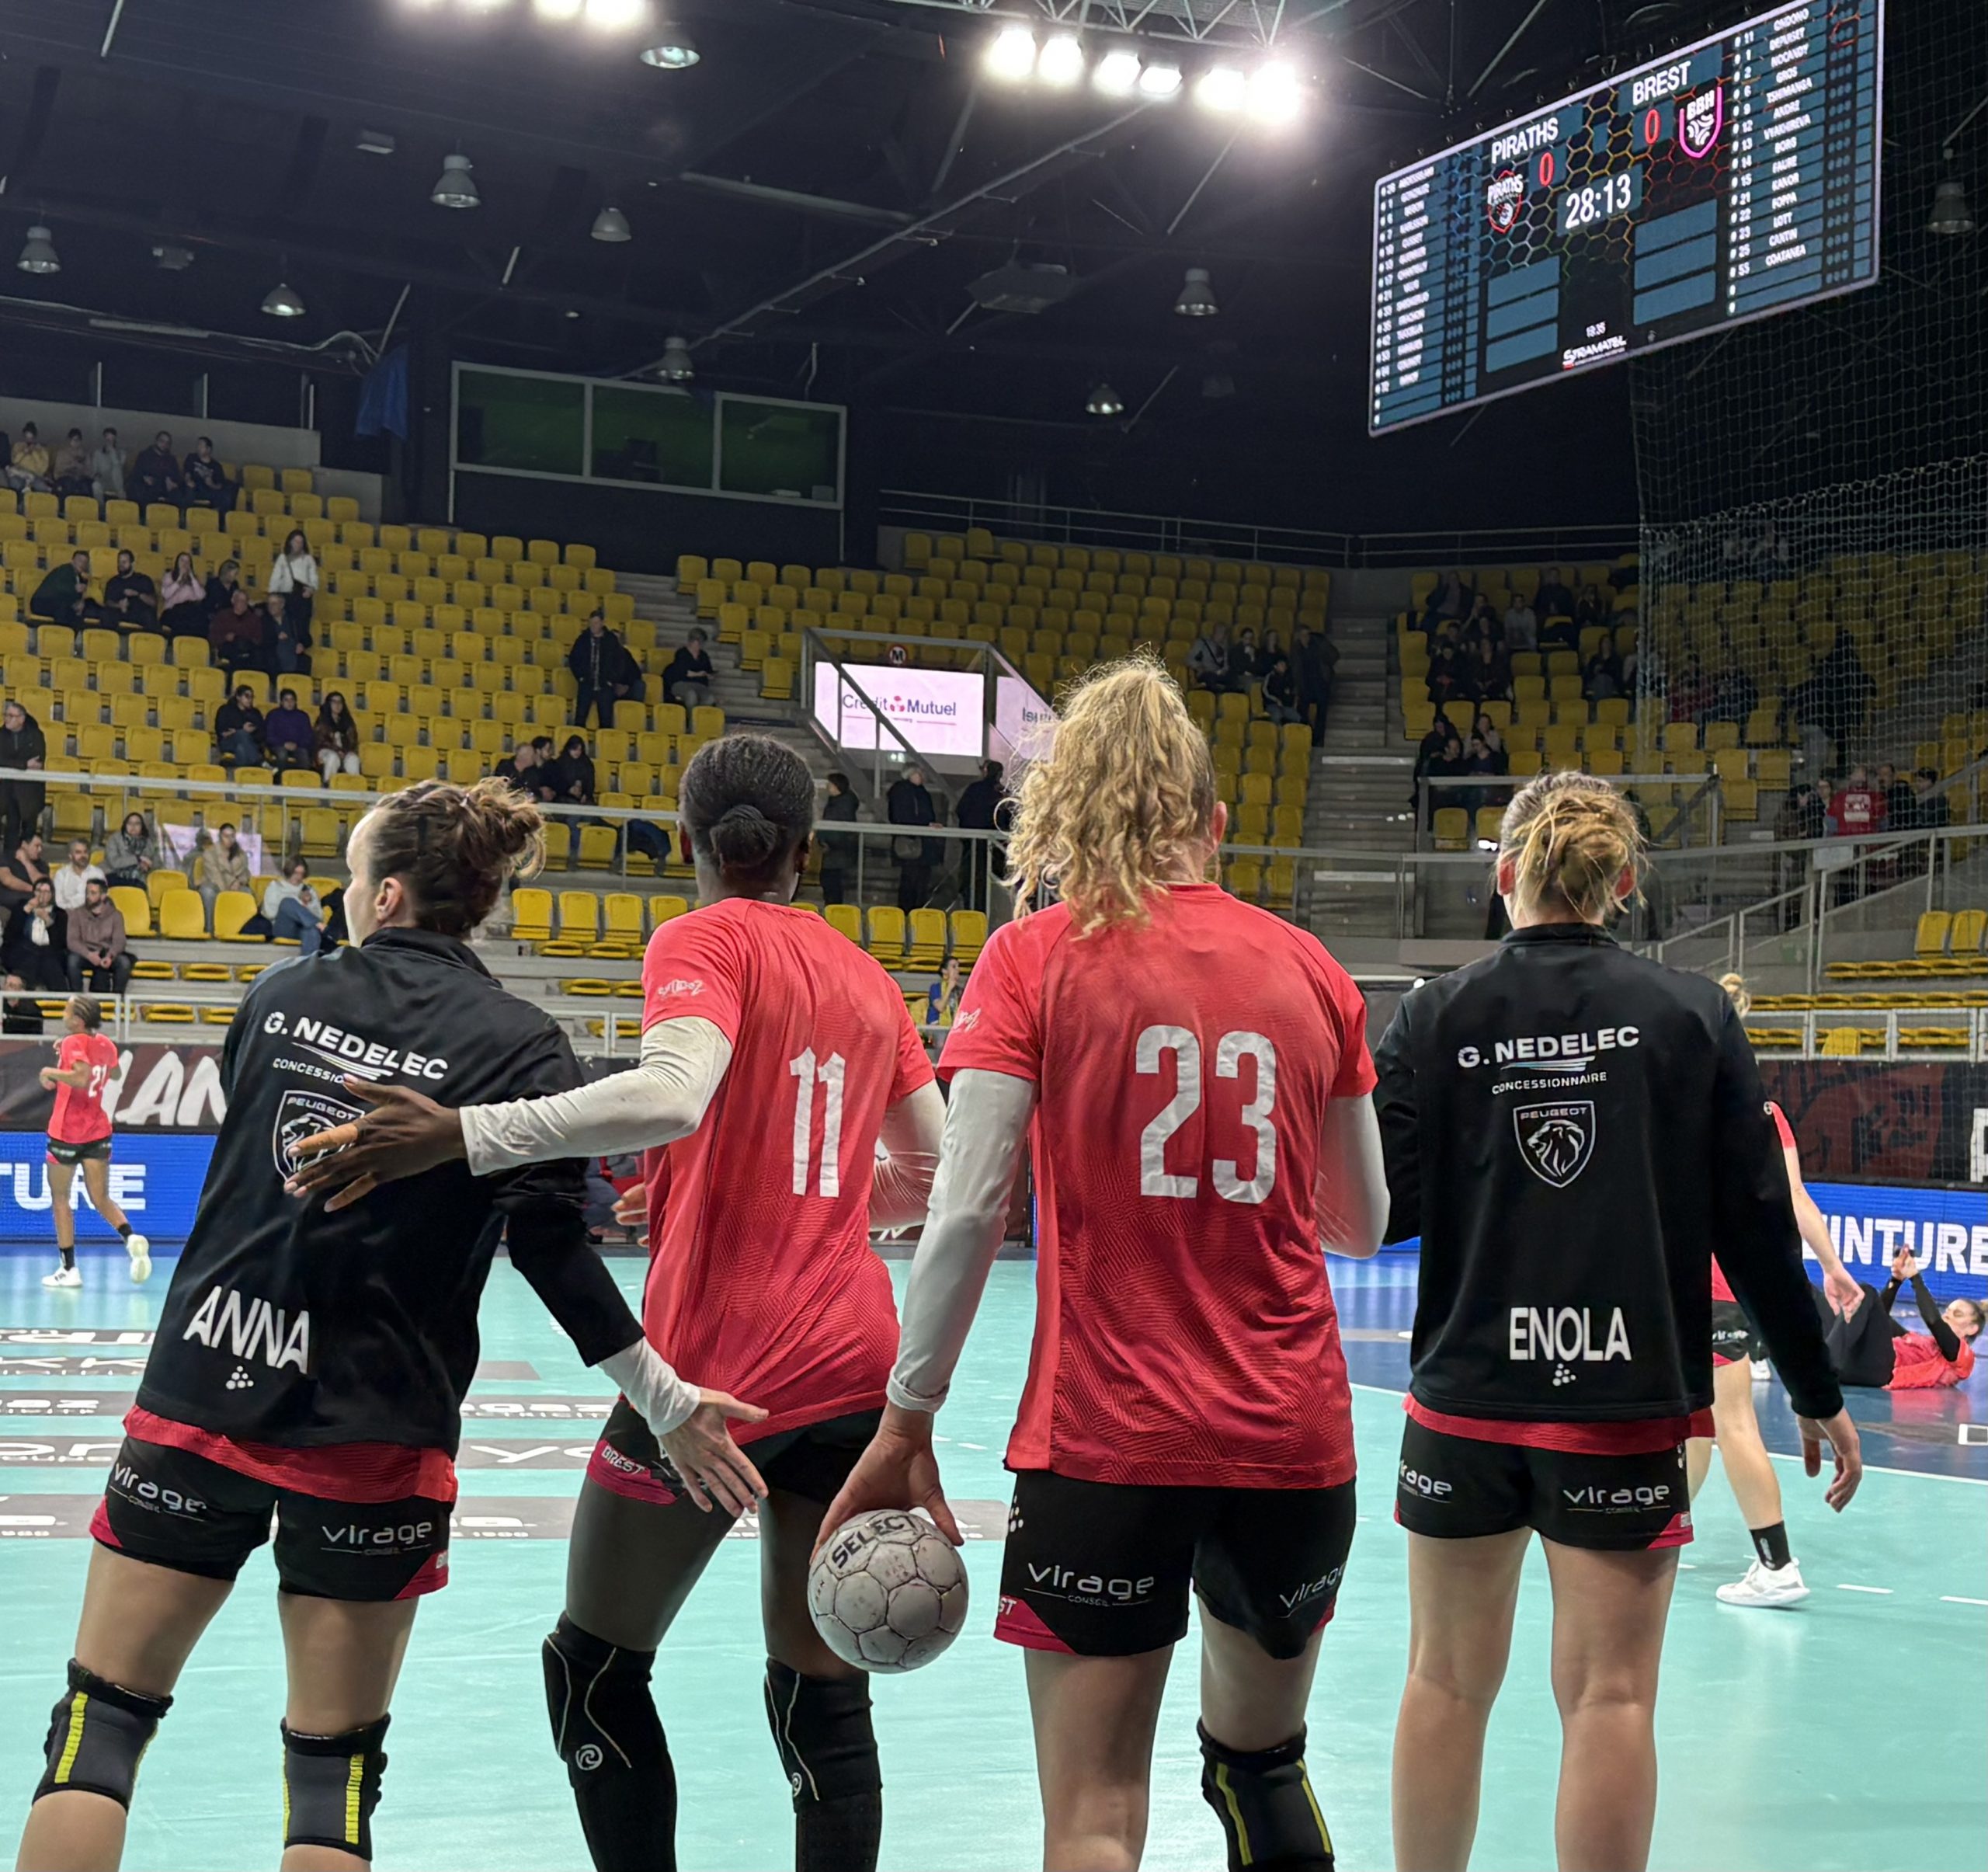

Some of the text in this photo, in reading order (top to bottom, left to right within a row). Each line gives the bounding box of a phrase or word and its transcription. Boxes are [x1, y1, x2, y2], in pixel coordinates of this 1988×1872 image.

[1633, 61, 1691, 106] BREST
[1687, 90, 1715, 120] BBH
[1492, 117, 1558, 164] PIRATHS
[1645, 109, 1660, 144] 0
[1539, 152, 1554, 186] 0
[1566, 173, 1631, 228] 28:13
[843, 694, 956, 715] Crit Mutuel
[293, 1017, 448, 1080] NEDELEC
[1495, 1026, 1639, 1063] NEDELEC
[1492, 1072, 1607, 1094] CONCESSIONNAIRE
[287, 1097, 356, 1121] PEUGEOT
[789, 1046, 845, 1198] 11
[1135, 1025, 1277, 1204] 23
[1521, 1107, 1587, 1119] PEUGEOT
[182, 1286, 309, 1374] ANNA
[1509, 1307, 1632, 1361] ENOLA
[601, 1445, 645, 1475] BREST
[114, 1463, 207, 1512] virage
[1562, 1485, 1670, 1505] virage
[321, 1522, 433, 1544] virage
[832, 1515, 918, 1569] SELECT
[1028, 1563, 1154, 1599] virage
